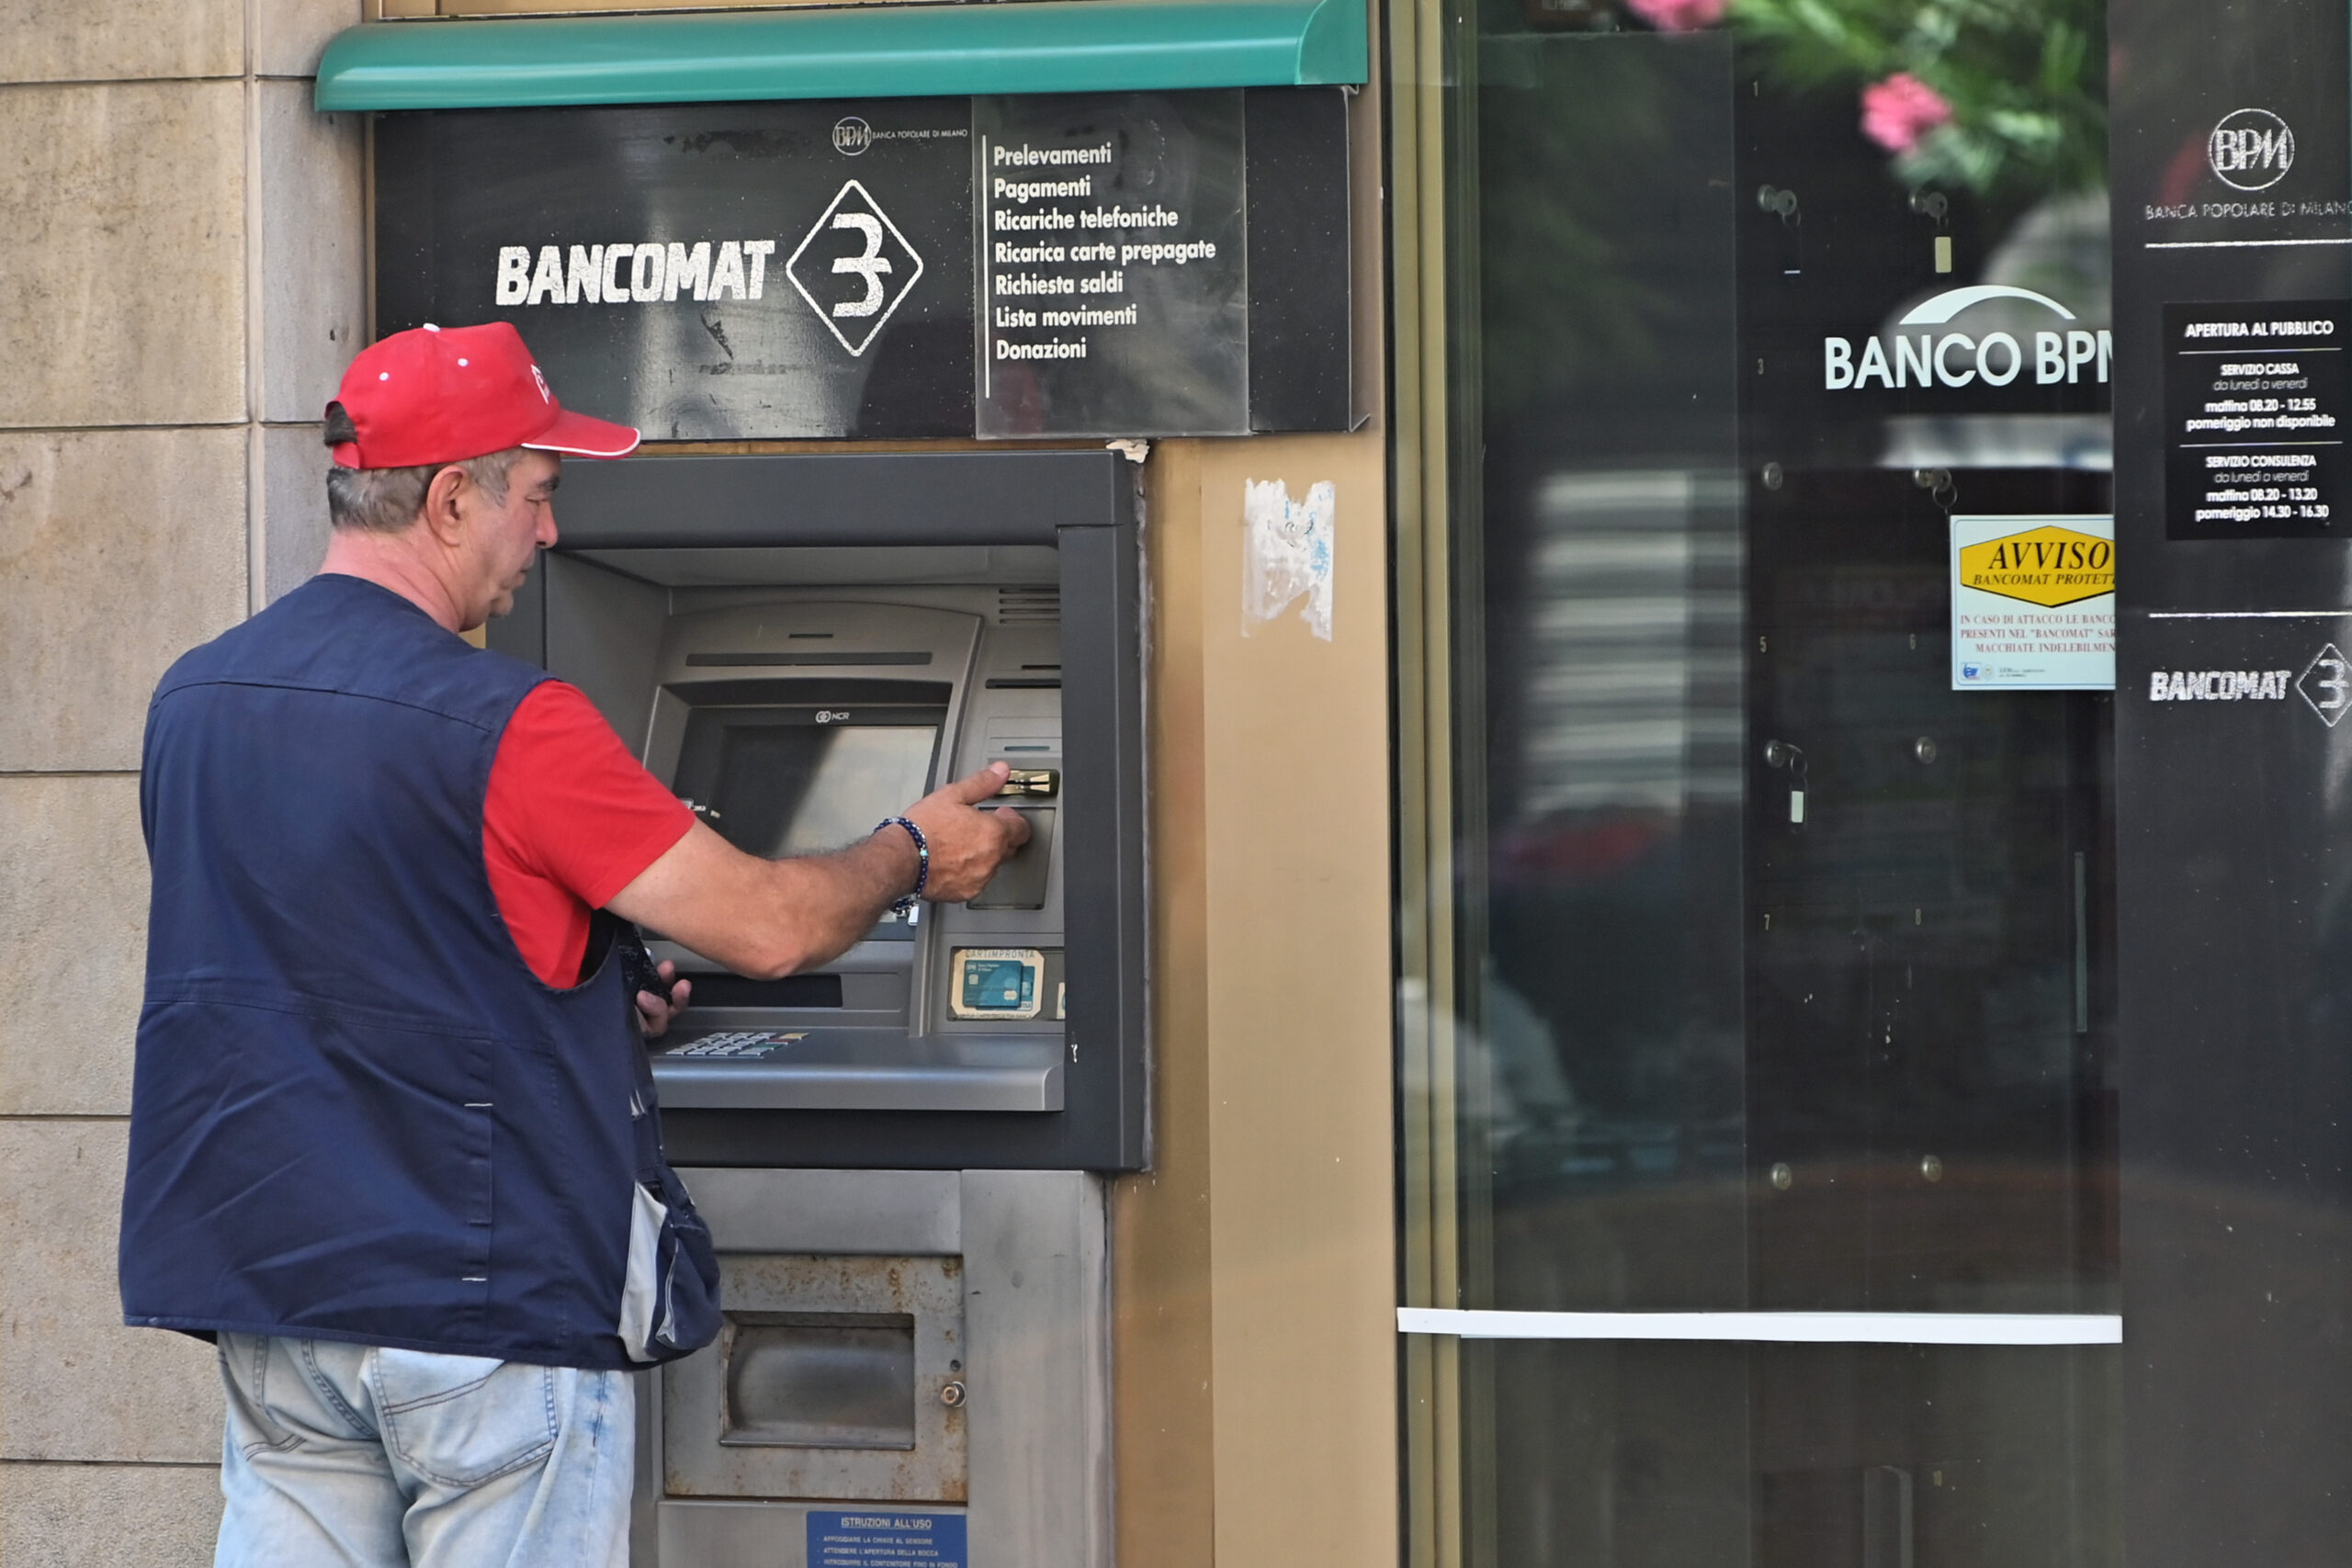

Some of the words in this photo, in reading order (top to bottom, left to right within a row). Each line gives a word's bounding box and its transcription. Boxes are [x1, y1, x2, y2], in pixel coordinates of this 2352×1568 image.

[933, 130, 940, 138] DI
[941, 129, 968, 137] MILANO
[994, 141, 1112, 166] Prelevamenti
[2215, 128, 2289, 171] BPM
[994, 175, 1091, 204] Pagamenti
[995, 207, 1075, 231] Ricariche
[1080, 204, 1179, 229] telefoniche
[2145, 204, 2198, 220] BANCA
[2203, 202, 2276, 219] POPOLARE
[2281, 201, 2295, 217] DI
[995, 241, 1065, 264] Ricarica
[1070, 243, 1115, 262] carte
[1121, 240, 1216, 265] prepagate
[495, 240, 775, 306] BANCOMAT
[996, 272, 1075, 295] Richiesta
[1080, 270, 1124, 294] saldi
[996, 306, 1036, 327] Lista
[1042, 303, 1137, 326] movimenti
[2185, 321, 2249, 338] APERTURA
[2250, 321, 2268, 336] AL
[2270, 320, 2335, 336] PUBBLICO
[996, 336, 1087, 359] Donazioni
[1825, 332, 2022, 390] BANCO
[2221, 364, 2265, 376] SERVIZIO
[2266, 363, 2300, 375] CASSA
[2205, 400, 2248, 413] mattina
[2249, 399, 2279, 412] 08.20
[2288, 398, 2316, 411] 12.55
[2187, 415, 2251, 433] pomeriggio
[2253, 418, 2275, 428] non
[2276, 414, 2335, 430] disponibile
[2206, 456, 2250, 468] SERVIZIO
[2251, 455, 2317, 468] CONSULENZA
[2206, 490, 2249, 502] mattina
[2250, 488, 2279, 501] 08.20
[2289, 488, 2318, 501] 13.20
[2195, 506, 2261, 522] pomeriggio
[2262, 505, 2291, 518] 14.30
[2300, 504, 2330, 518] 16.30
[1988, 541, 2110, 570] AVVISO
[1973, 573, 2052, 585] BANCOMAT
[1961, 615, 1971, 625] IN
[1973, 614, 2000, 625] CASO
[2004, 615, 2014, 625] DI
[2018, 615, 2063, 625] ATTACCO
[2066, 614, 2079, 625] LE
[1961, 629, 2006, 638] PRESENTI
[2009, 629, 2028, 638] NEL
[1976, 643, 2035, 653] MACCHIATE
[2149, 671, 2292, 702] BANCOMAT
[831, 712, 850, 720] NCR
[966, 949, 1035, 959] CARTIMPRONTA
[842, 1517, 891, 1528] ISTRUZIONI
[894, 1518, 933, 1529] ALL'USO
